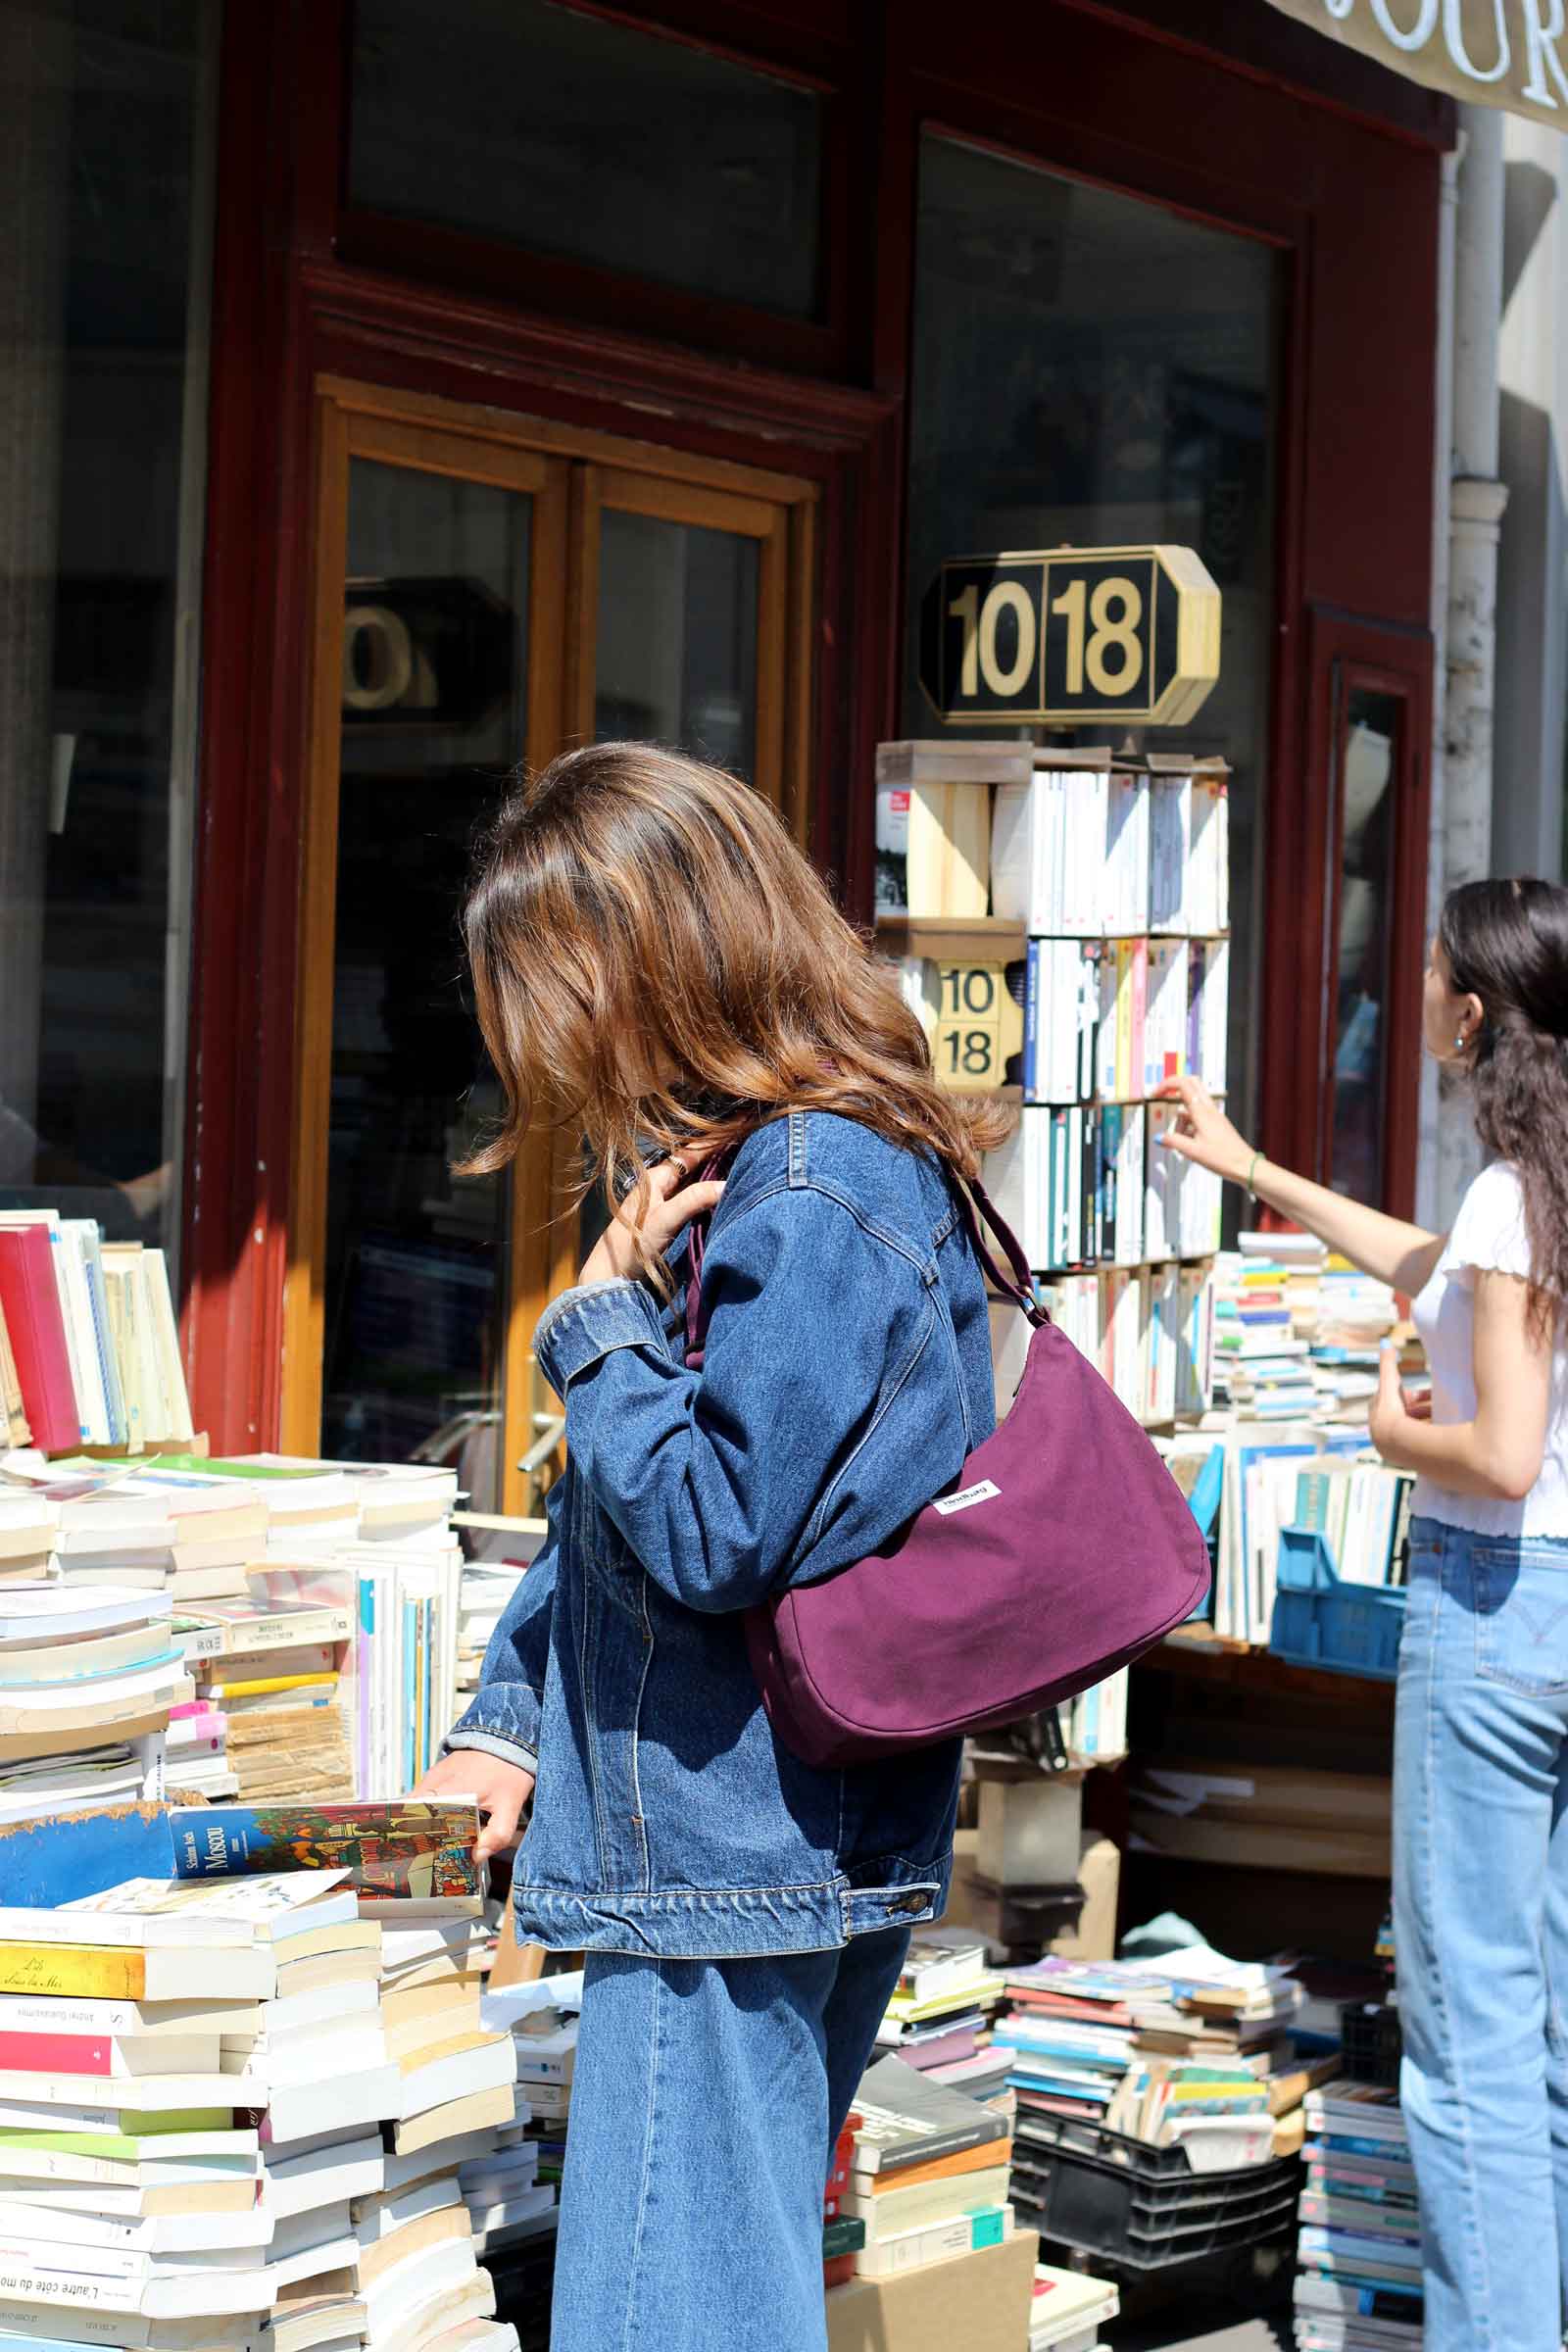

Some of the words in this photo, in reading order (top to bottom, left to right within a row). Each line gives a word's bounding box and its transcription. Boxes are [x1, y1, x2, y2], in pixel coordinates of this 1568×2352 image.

[949, 581, 1036, 697] 10
[1052, 577, 1144, 696] 18
[943, 968, 994, 1014] 10
[944, 1030, 992, 1075] 18
[204, 1826, 228, 1871] Moscou
[20, 2278, 32, 2290] du
